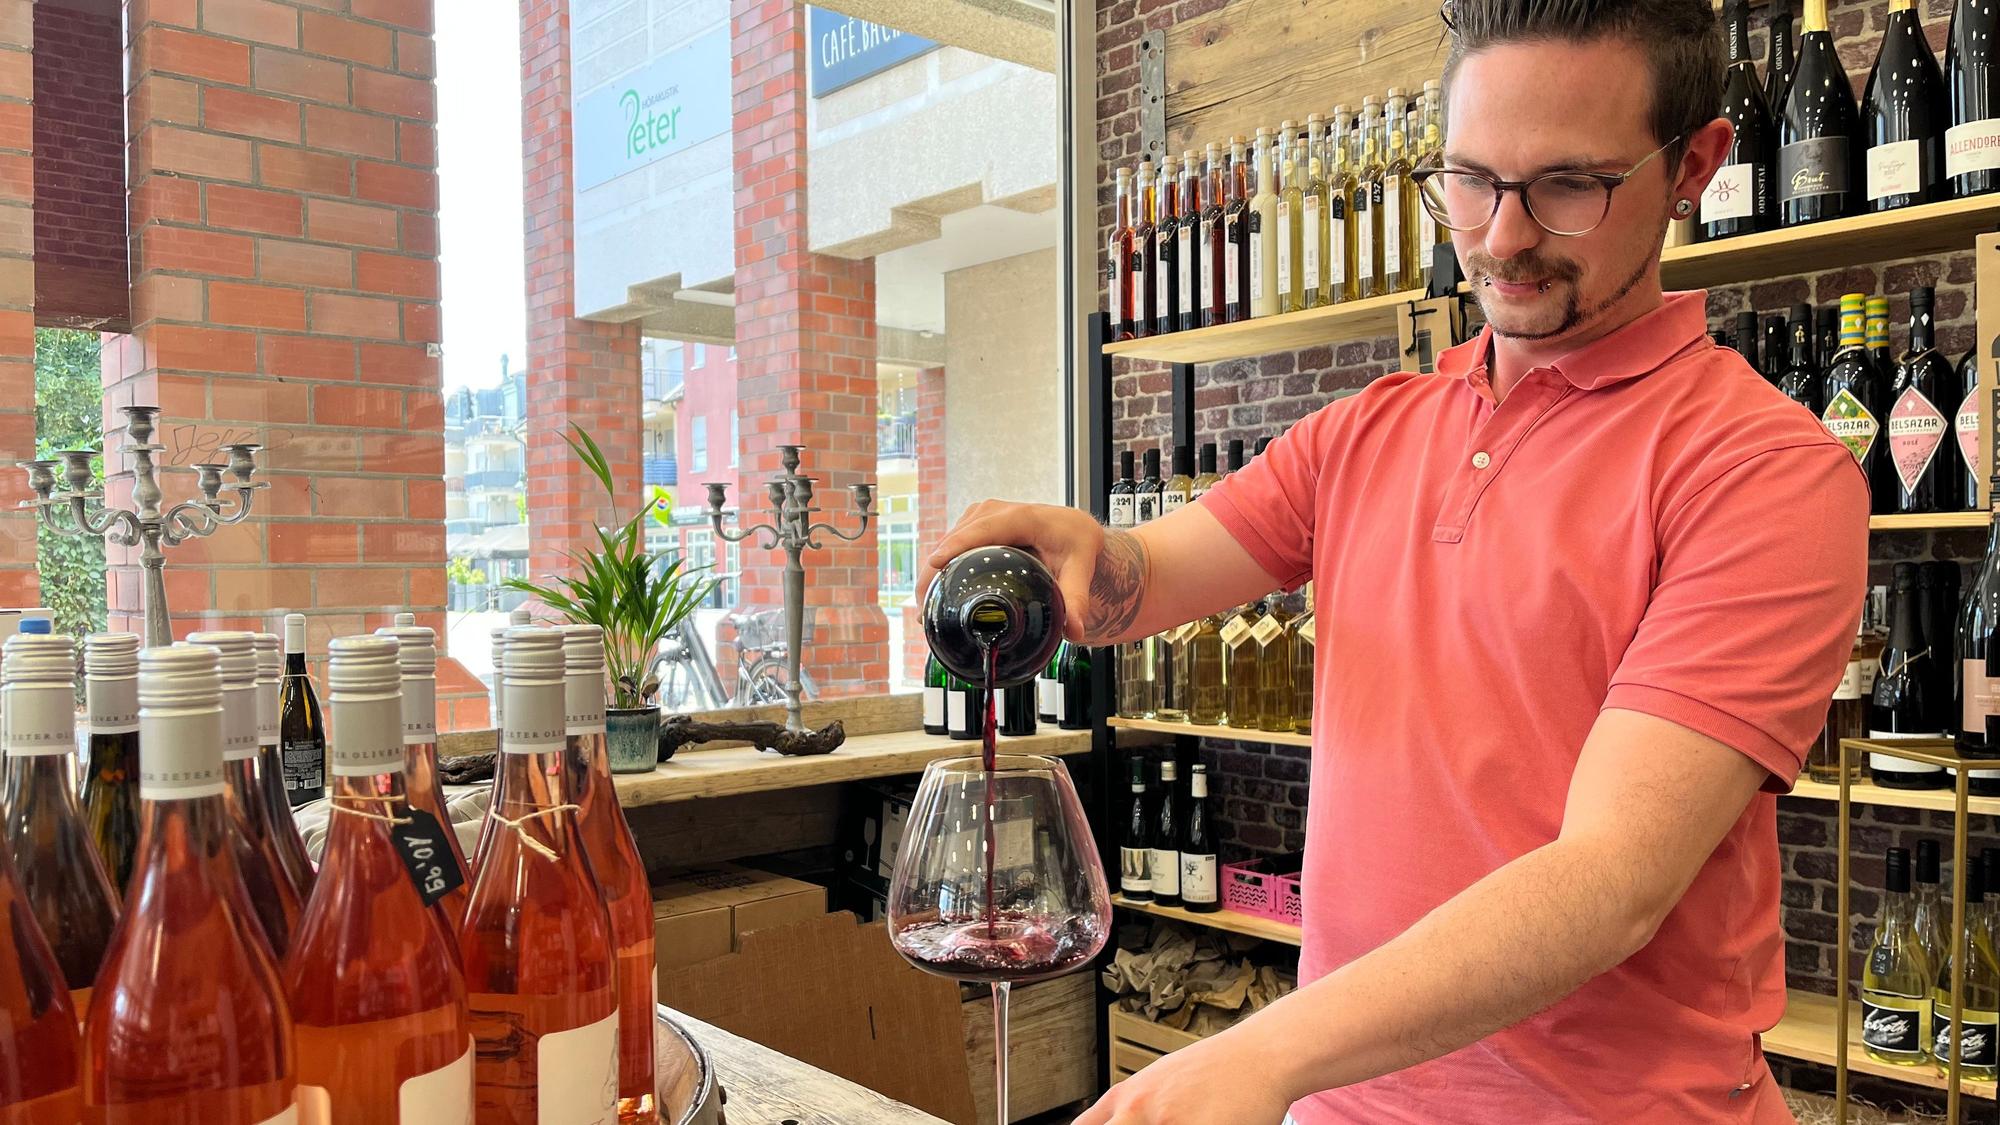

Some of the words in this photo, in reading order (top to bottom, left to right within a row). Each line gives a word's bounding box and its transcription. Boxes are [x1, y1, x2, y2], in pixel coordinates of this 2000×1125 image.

[1730, 20, 1738, 60] ODINSTAL
[1774, 31, 1783, 71] ODINSTAL
[1758, 165, 1766, 214] ODINSTAL
[1825, 420, 1870, 431] ELSAZAR
[1891, 418, 1938, 431] BELSAZAR
[403, 836, 446, 894] 10,99
